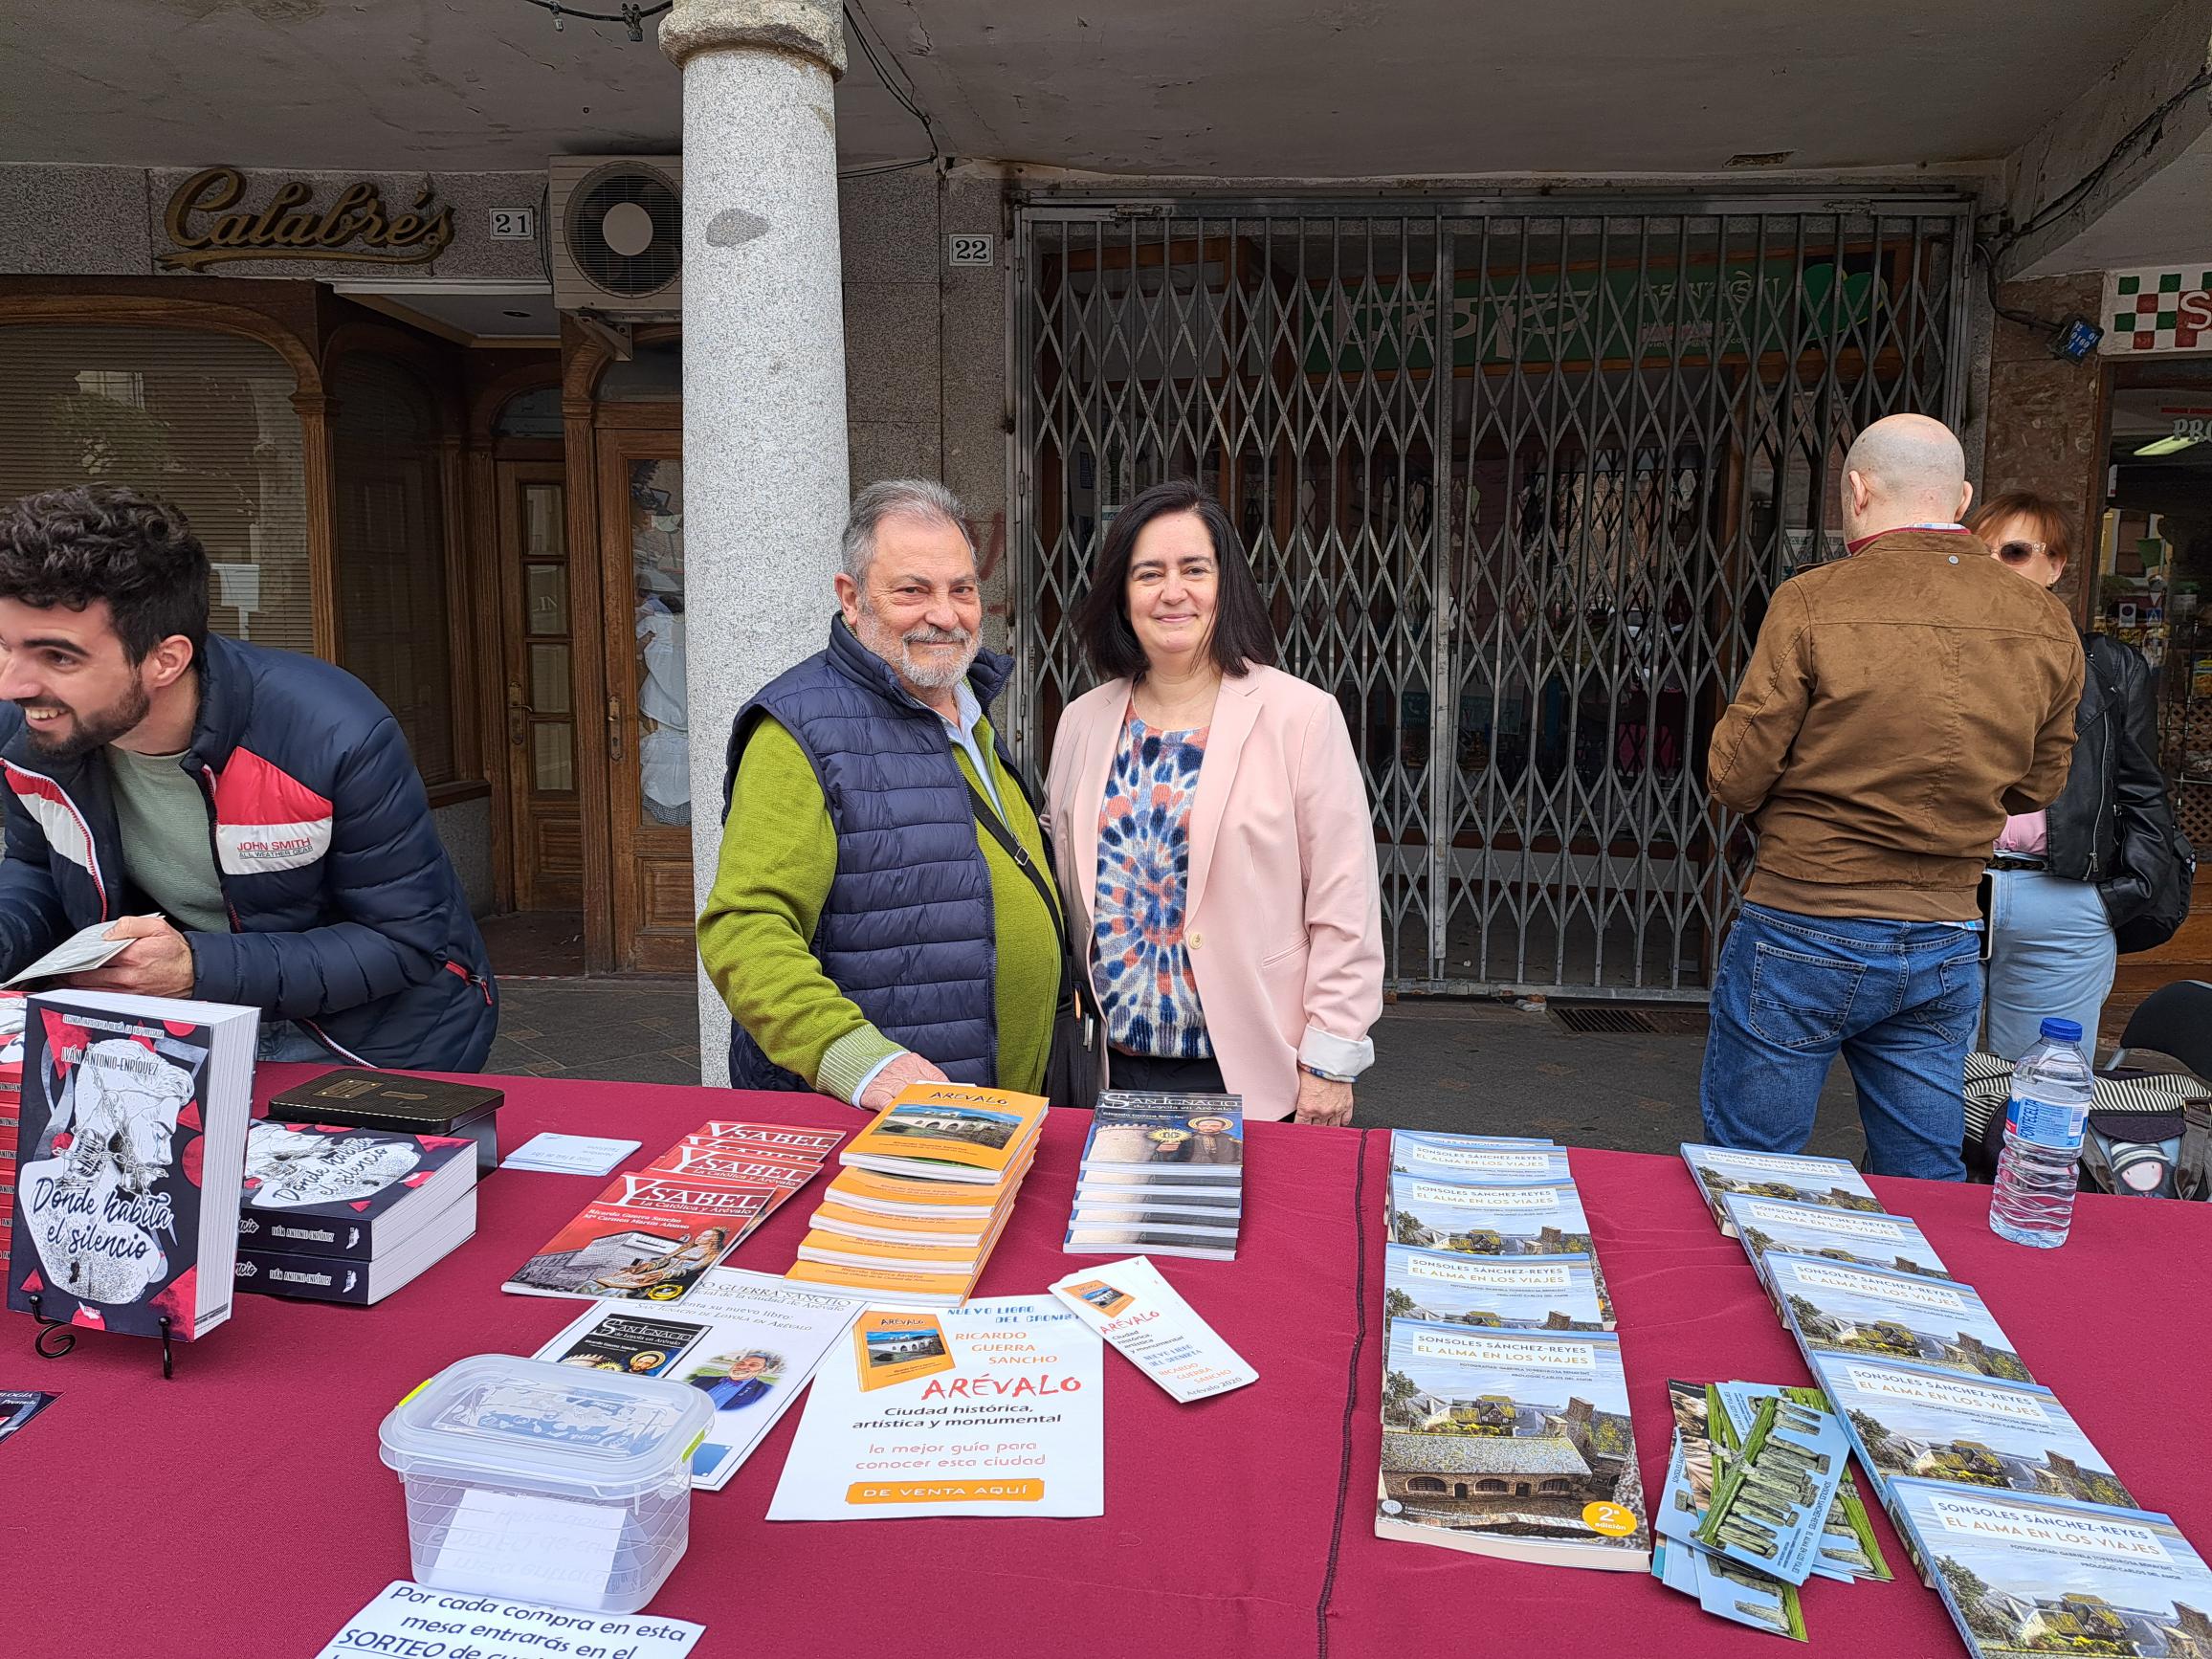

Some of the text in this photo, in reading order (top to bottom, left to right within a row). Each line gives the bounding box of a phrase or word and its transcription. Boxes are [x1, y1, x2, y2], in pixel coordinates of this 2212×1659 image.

[156, 167, 455, 266] Calabrés
[495, 214, 528, 233] 21
[955, 239, 986, 259] 22
[236, 837, 311, 851] JOHN SMITH
[293, 846, 313, 855] GEAR
[62, 1045, 159, 1075] IVÁN ANTONIO-ENRÍQUEZ
[929, 1091, 1009, 1106] ARÉVALO
[1103, 1094, 1238, 1108] SAN IGNACIO
[2020, 1099, 2040, 1139] FONTECELTA
[708, 1122, 830, 1148] YSABEL
[1416, 1147, 1465, 1158] SONSOLES
[1430, 1156, 1461, 1164] ALMA
[321, 1147, 387, 1196] el silencio
[672, 1145, 804, 1182] YSABEL
[273, 1168, 329, 1202] Donde
[706, 1170, 746, 1181] Católica
[757, 1175, 796, 1186] Arévalo
[612, 1175, 763, 1208] YSABEL
[1416, 1185, 1469, 1196] SONSOLES
[1433, 1194, 1466, 1203] ALMA
[33, 1178, 173, 1228] Donde habita
[654, 1202, 698, 1212] Católica
[699, 1205, 708, 1213] y
[709, 1206, 752, 1215] Arévalo
[597, 1216, 630, 1225] Carmen
[652, 1215, 681, 1224] Sancho
[48, 1219, 150, 1260] el silencio
[1412, 1259, 1562, 1274] SONSOLES SÁNCHEZ-REYES
[1430, 1270, 1466, 1280] ALMA
[1797, 1266, 1954, 1298] SONSOLES SÁNCHEZ-REYES
[719, 1283, 778, 1297] GUERRA
[783, 1292, 852, 1306] SANCHO
[1820, 1277, 1858, 1290] ALMA
[1862, 1284, 1878, 1293] EN
[1883, 1288, 1909, 1297] LOS
[1913, 1294, 1959, 1307] VIAJES
[747, 1294, 784, 1304] ciudad
[801, 1301, 845, 1312] Arévalo
[947, 1305, 1035, 1316] NUEVO LIBRO
[657, 1305, 696, 1315] IGNACIO
[714, 1312, 750, 1322] LOYOLA
[768, 1319, 812, 1331] ARÉVALO
[725, 1307, 760, 1316] nuevo
[763, 1309, 793, 1320] libro:
[881, 1317, 924, 1326] ARÉVALO
[1099, 1310, 1160, 1334] ARÉVALO
[638, 1324, 695, 1341] IGNACIO
[955, 1332, 1027, 1340] RICARDO
[1112, 1330, 1139, 1340] Ciudad
[1117, 1334, 1153, 1345] histórica,
[1136, 1336, 1184, 1352] monumental
[1418, 1335, 1587, 1354] SONSOLES SÁNCHEZ-REYES
[988, 1355, 1058, 1364] SANCHO
[1438, 1348, 1477, 1358] ALMA
[1506, 1353, 1532, 1361] LOS
[1538, 1355, 1588, 1364] VIAJES
[1159, 1362, 1199, 1376] RICARDO
[1176, 1367, 1212, 1380] GUERRA
[1195, 1369, 1231, 1383] SANCHO
[921, 1374, 1082, 1401] ARÉVALO
[1186, 1377, 1242, 1396] Arévalo 2020
[1853, 1370, 2032, 1405] SONSOLES SÁNCHEZ-REYES
[1859, 1381, 2041, 1417] EL ALMA EN LOS VIAJES
[884, 1404, 1034, 1416] Ciudad histórica,
[852, 1414, 1061, 1428] artística y monumental
[869, 1441, 1037, 1455] la mejor guía para
[855, 1454, 1046, 1470] conocer esta ciudad
[863, 1484, 1028, 1497] DE VENTA AQUÍ
[1599, 1506, 1619, 1521] 2ª
[1938, 1502, 2149, 1539] SONSOLES SÁNCHEZ-REYES
[1594, 1521, 1626, 1531] edición
[1945, 1516, 2160, 1555] EL ALMA EN LOS VIAJES
[389, 1586, 686, 1642] Por cada compra en esta
[338, 1628, 446, 1658] SORTEO
[448, 1644, 482, 1659] de
[400, 1615, 466, 1635] mesa
[470, 1624, 571, 1652] entrarás
[575, 1644, 607, 1658] en
[612, 1645, 638, 1659] el
